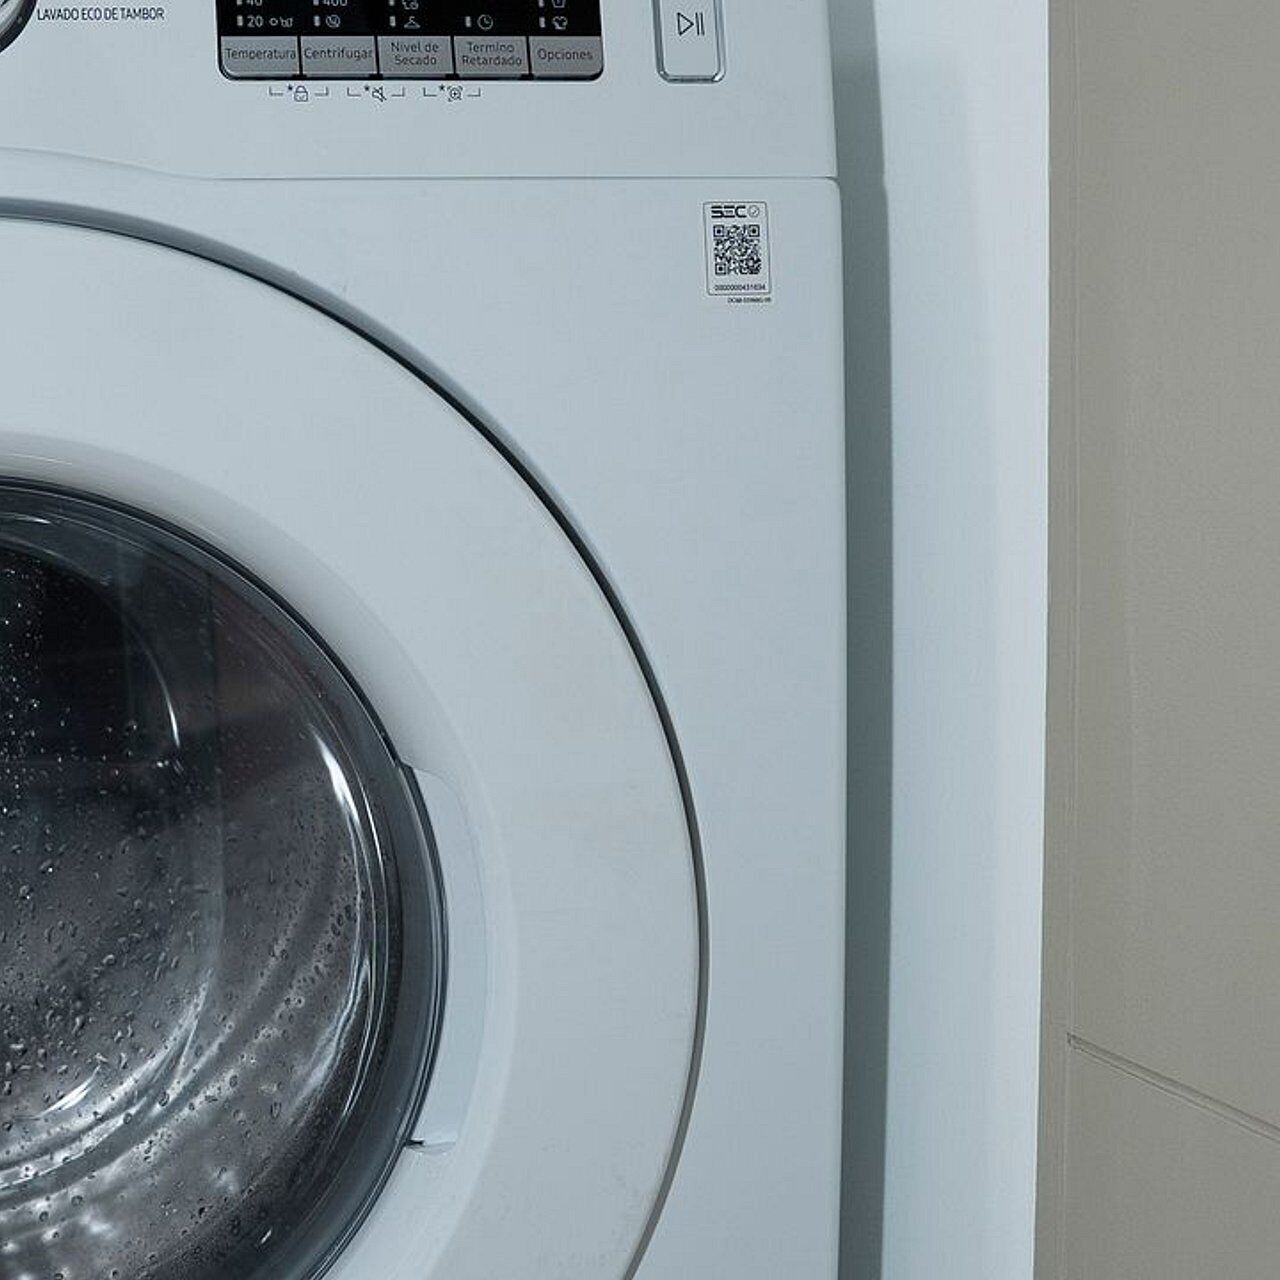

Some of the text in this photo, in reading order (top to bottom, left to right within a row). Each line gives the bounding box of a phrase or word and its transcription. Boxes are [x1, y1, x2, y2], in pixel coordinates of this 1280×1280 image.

[37, 7, 165, 21] LAVADO ECO DE TAMBOR
[247, 15, 264, 28] 20
[391, 41, 439, 53] Nivel de
[469, 41, 515, 53] Termino
[225, 47, 297, 61] Temperatura
[303, 47, 373, 62] Centrifugar
[394, 54, 437, 66] Secado
[462, 55, 523, 66] Retardado
[537, 48, 593, 61] Opciones
